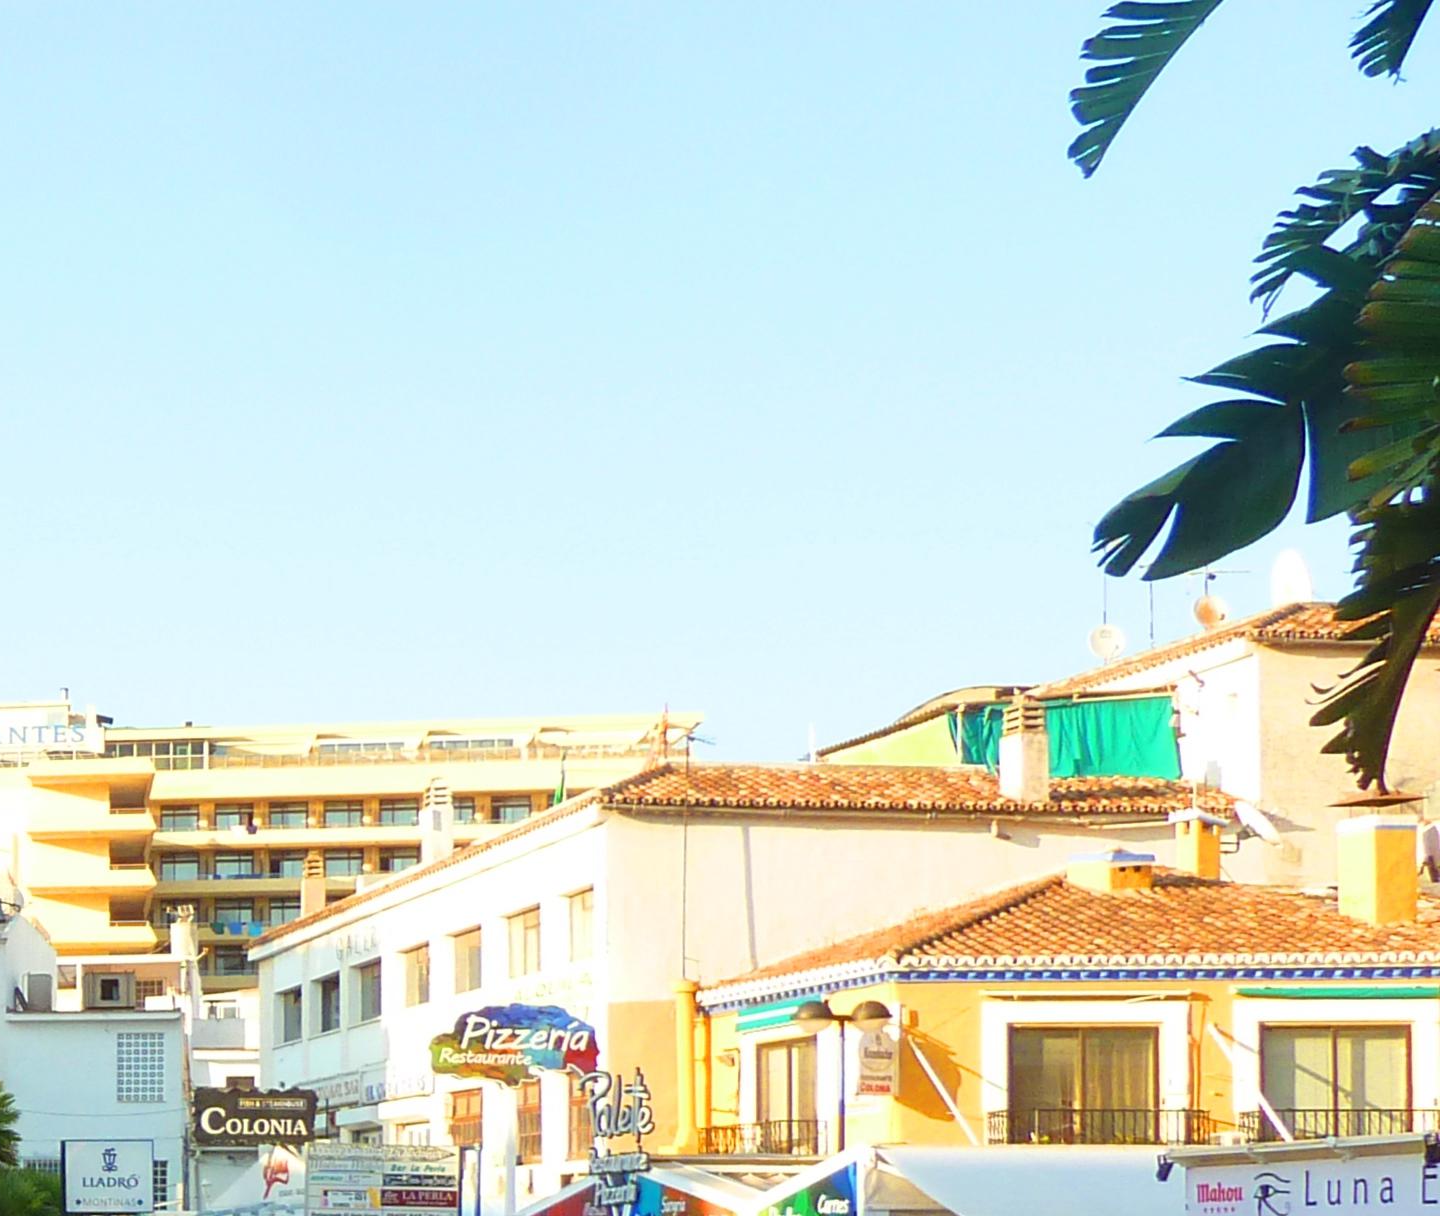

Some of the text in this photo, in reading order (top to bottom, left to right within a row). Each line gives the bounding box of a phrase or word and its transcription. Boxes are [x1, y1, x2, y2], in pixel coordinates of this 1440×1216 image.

[460, 1014, 589, 1051] Pizzería
[439, 1047, 532, 1066] Restaurante
[82, 1175, 139, 1190] LLADRÓ
[1197, 1182, 1244, 1204] Mahou
[1305, 1170, 1395, 1207] Luna
